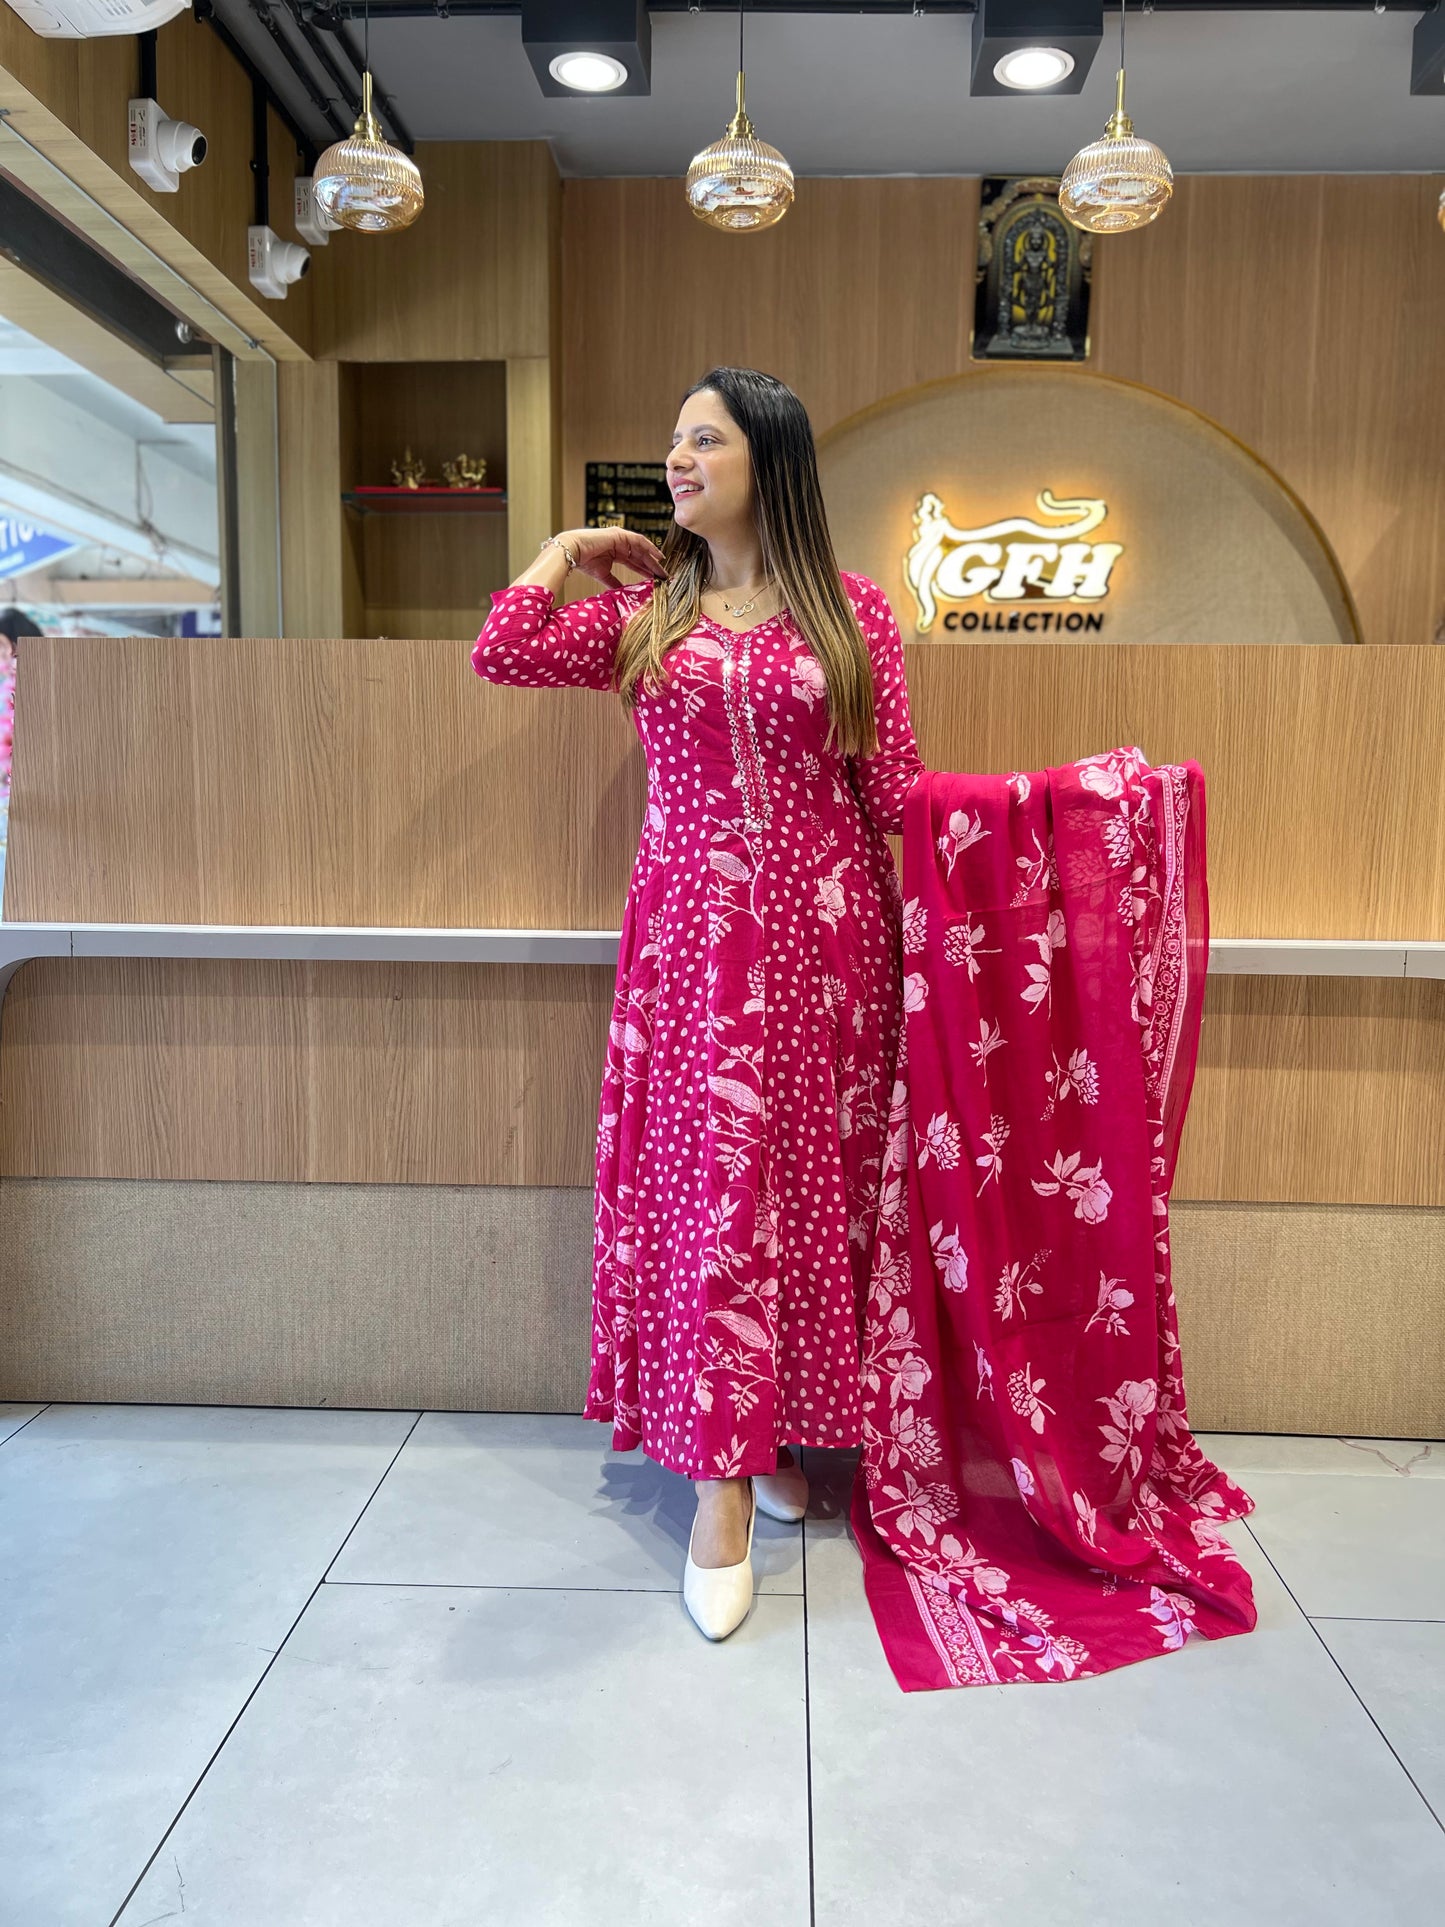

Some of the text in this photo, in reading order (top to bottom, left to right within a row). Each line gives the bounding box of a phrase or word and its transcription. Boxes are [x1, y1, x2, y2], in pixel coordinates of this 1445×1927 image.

[597, 464, 665, 482] No Exchang
[627, 515, 671, 531] Paymen
[936, 542, 1124, 599] GFH
[943, 611, 1104, 633] COLLECTION
